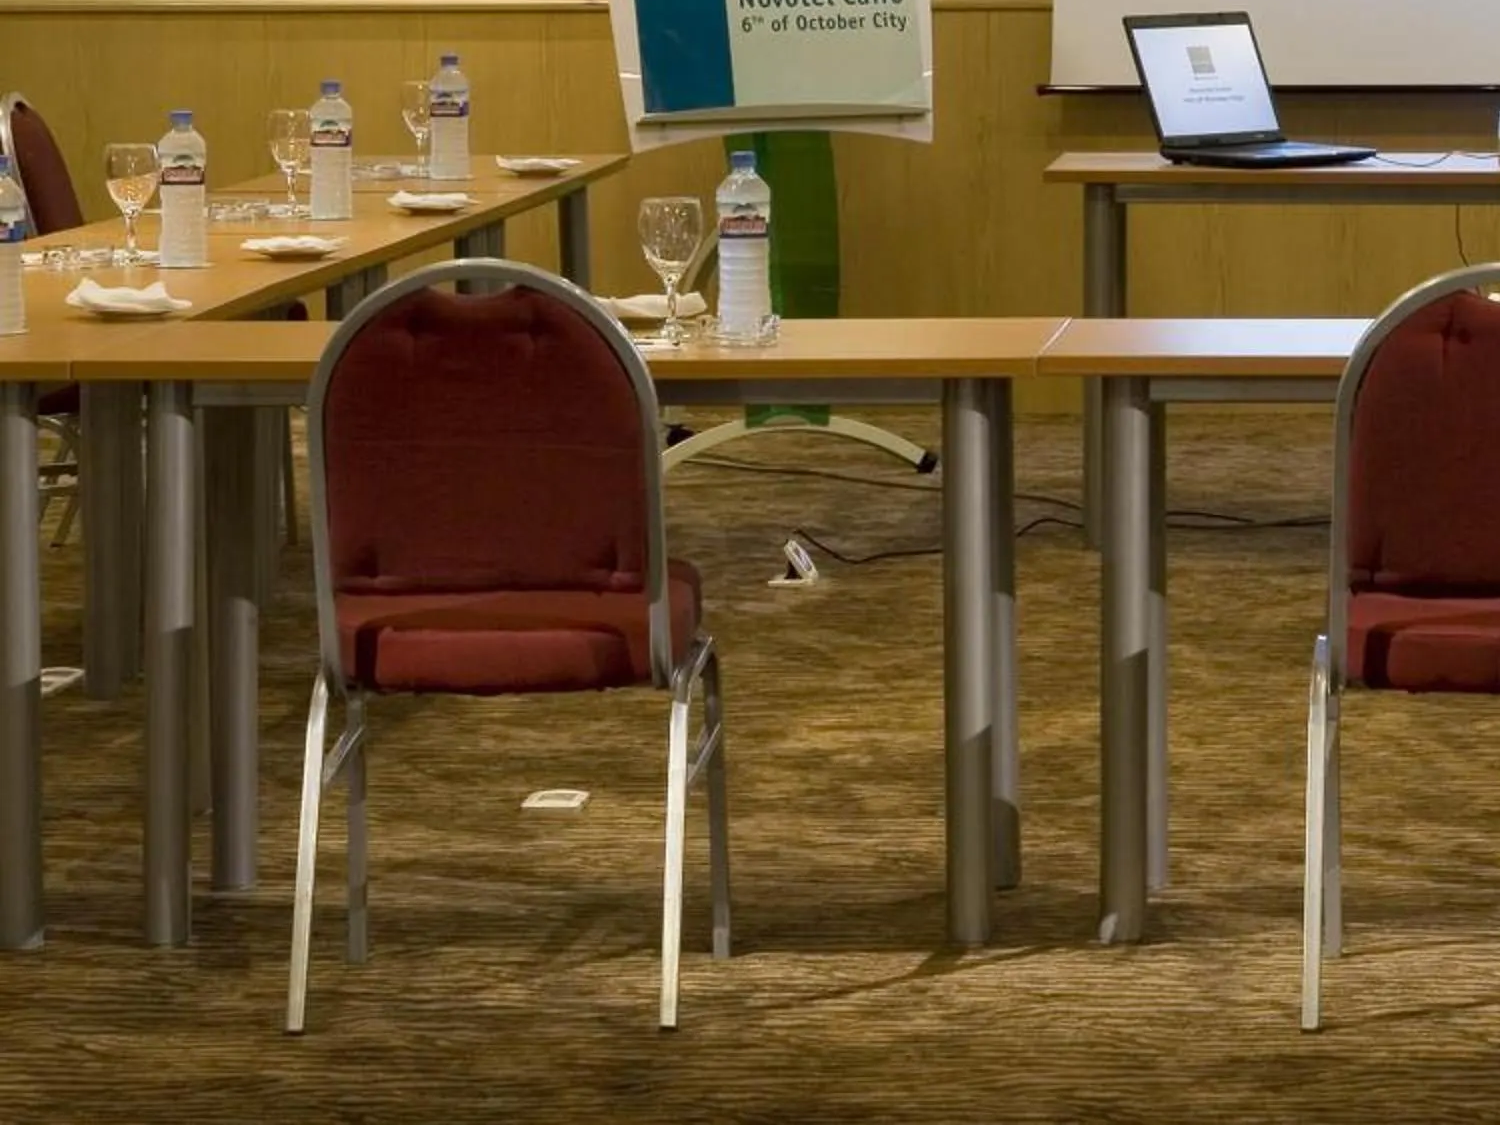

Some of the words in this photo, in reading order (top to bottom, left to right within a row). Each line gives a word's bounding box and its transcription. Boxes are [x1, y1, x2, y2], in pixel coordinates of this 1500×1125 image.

[771, 14, 789, 33] of
[796, 13, 866, 31] October
[872, 11, 908, 32] City
